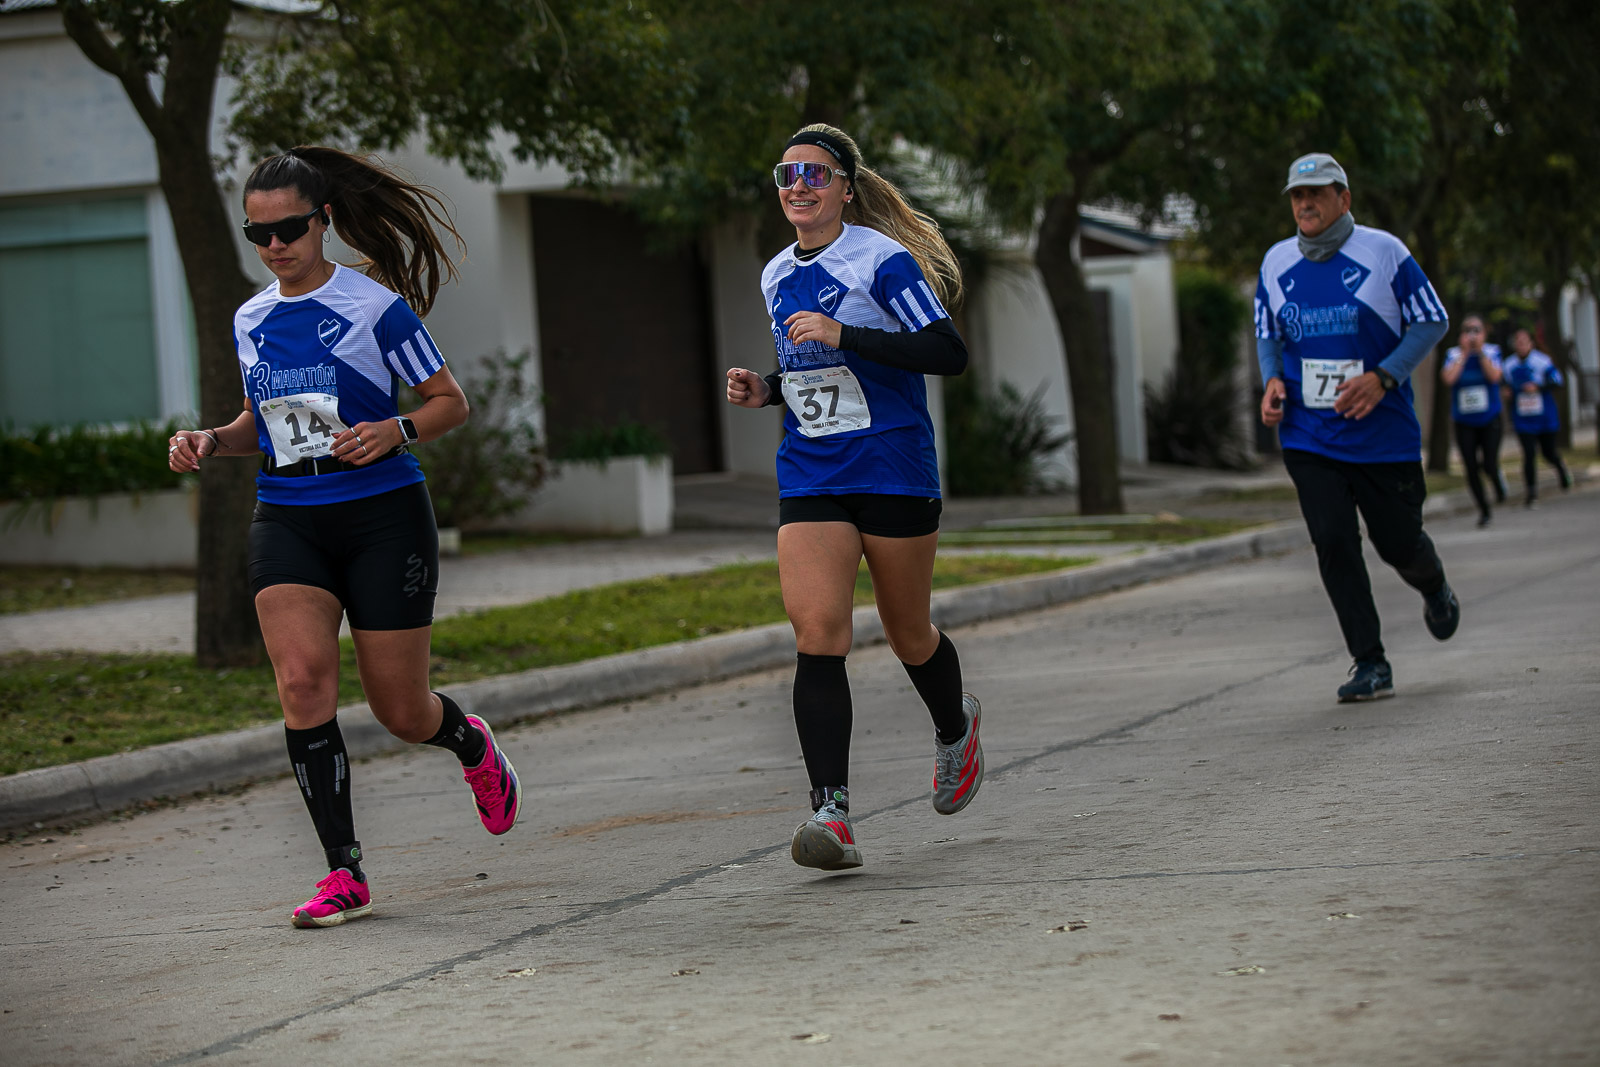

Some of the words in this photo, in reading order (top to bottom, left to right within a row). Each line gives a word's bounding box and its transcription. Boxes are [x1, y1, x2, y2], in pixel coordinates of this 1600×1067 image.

[1281, 302, 1302, 343] 3
[1302, 302, 1359, 324] MARATÓN
[253, 362, 271, 407] 3
[271, 363, 337, 390] MARATÓN
[797, 384, 840, 422] 37
[1316, 373, 1346, 397] 77
[285, 411, 332, 446] 14
